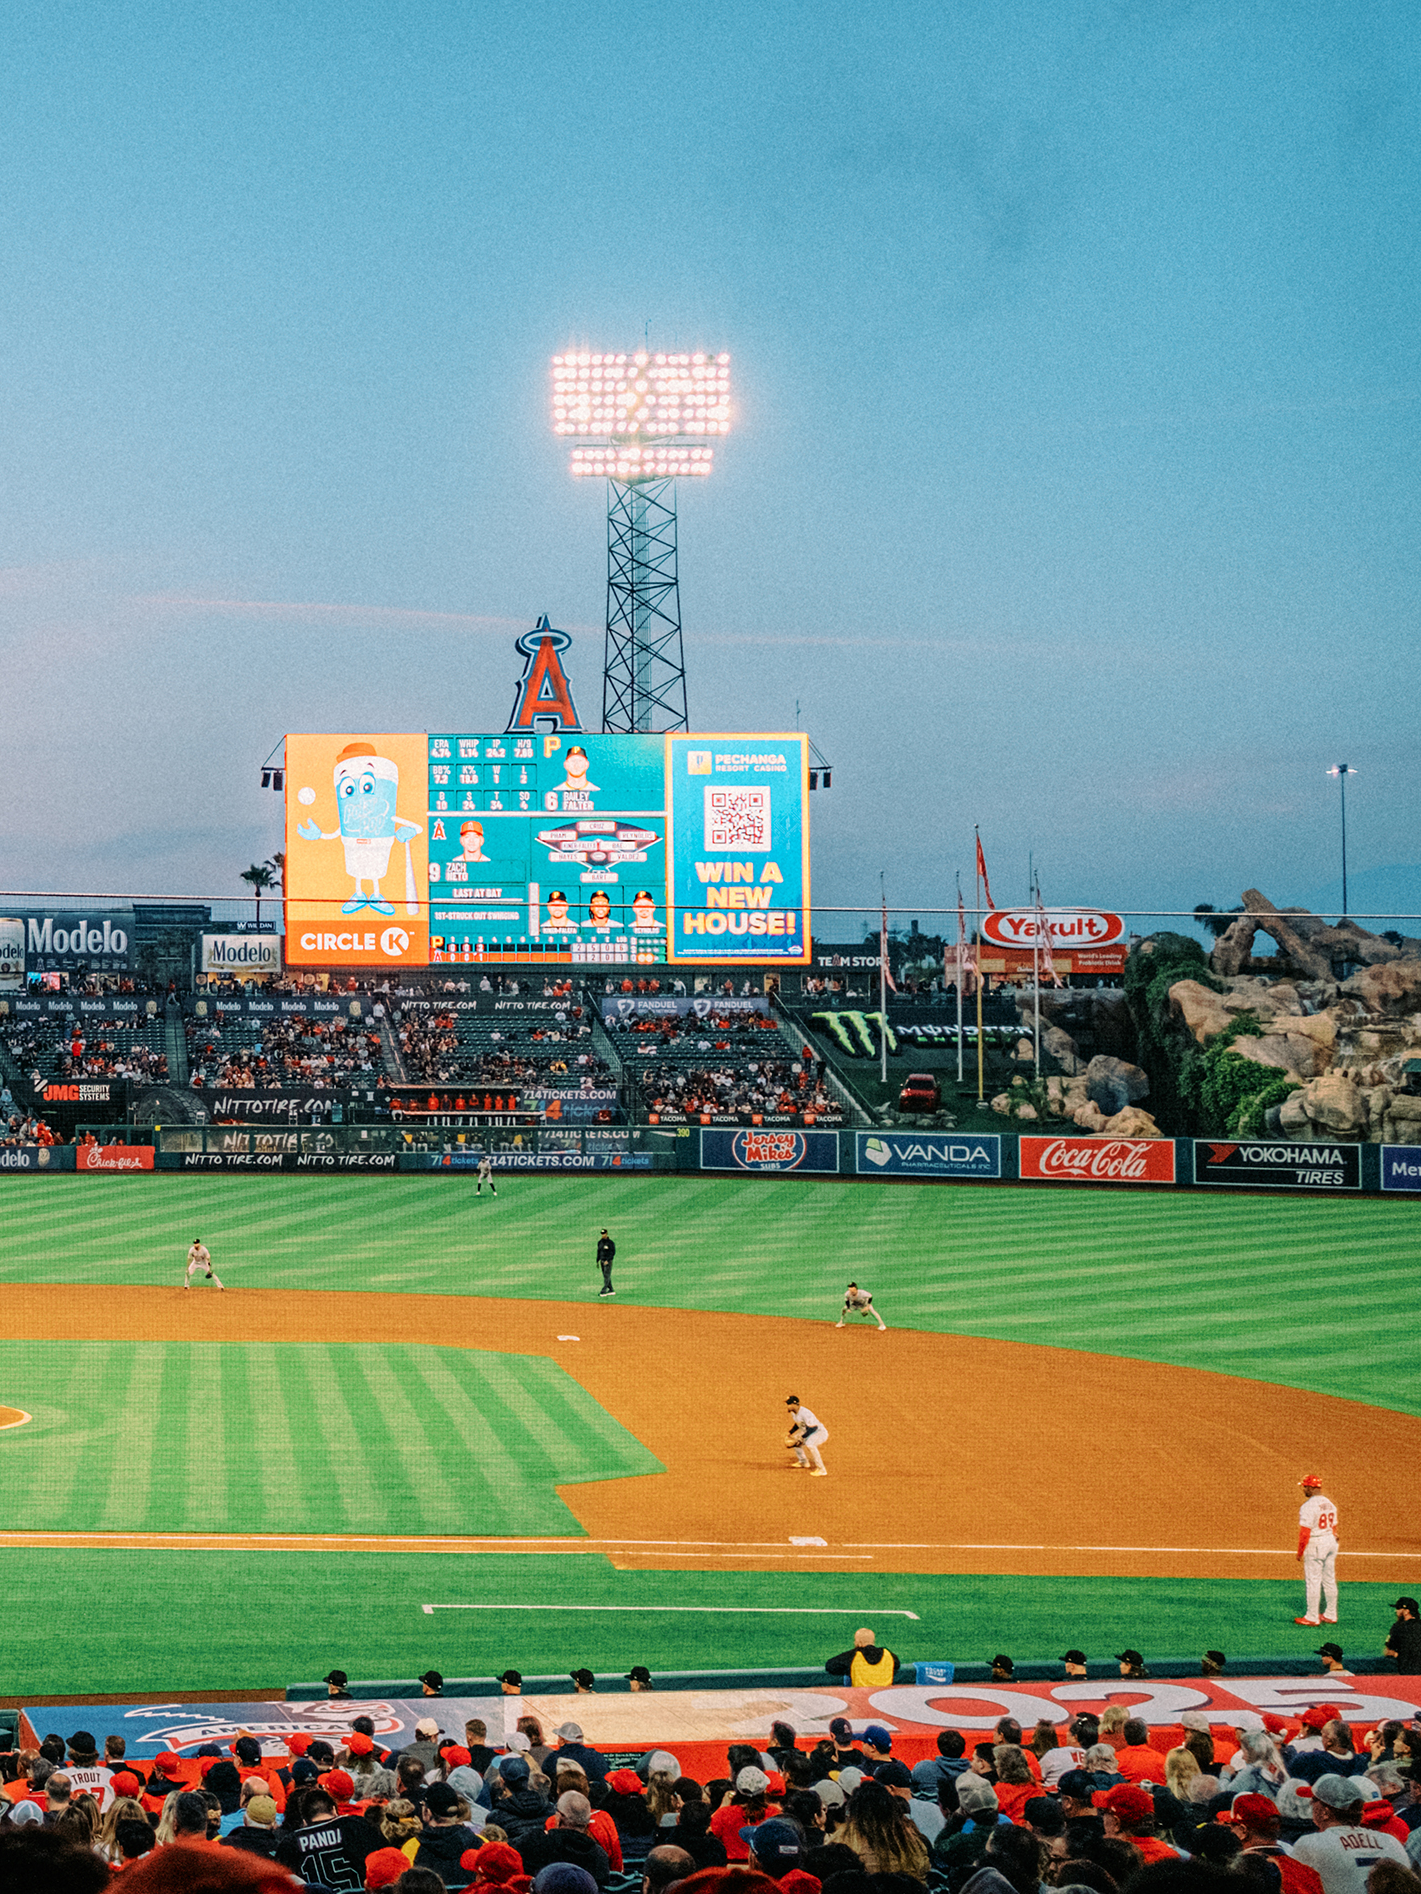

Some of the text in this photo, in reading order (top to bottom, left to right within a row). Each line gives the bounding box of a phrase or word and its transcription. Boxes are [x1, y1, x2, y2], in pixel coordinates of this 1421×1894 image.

[434, 740, 449, 748] ERA
[459, 740, 479, 748] WHIP
[492, 740, 501, 748] IP
[544, 736, 561, 758] P
[715, 754, 786, 765] PECHANGA
[462, 765, 476, 775] K%
[492, 766, 501, 775] W
[545, 792, 590, 811] 6 BAILEY
[563, 801, 594, 811] FALTER
[429, 863, 440, 882] 9
[695, 862, 784, 883] WIN A
[452, 888, 474, 898] LAST
[474, 888, 486, 898] AT
[707, 886, 773, 909] NEW
[683, 912, 796, 935] HOUSE!
[1006, 918, 1102, 937] Yakult
[27, 918, 128, 954] Modelo
[300, 927, 410, 956] CIRCLE K
[213, 940, 271, 962] Modelo
[817, 952, 851, 967] TEAM
[16, 1001, 41, 1011] Modelo
[48, 1001, 73, 1011] Modelo
[80, 1001, 106, 1011] Modelo
[112, 1001, 138, 1011] Modelo
[216, 1001, 241, 1011] Modelo
[249, 1001, 274, 1011] Modelo
[281, 1001, 306, 1011] Modelo
[314, 1001, 339, 1011] Modelo
[401, 1000, 476, 1010] NITTO TIRE.COM
[495, 1000, 571, 1010] NITTO TIRE.COM
[638, 1001, 677, 1009] FANDUEL
[714, 1001, 753, 1009] FANDUEL
[897, 1025, 1034, 1036] MONSTER
[43, 1085, 110, 1101] JMG SECURITY
[80, 1093, 110, 1101] SYSTEMS
[523, 1090, 617, 1100] 714TICKETS.COM
[712, 1115, 739, 1123] TACOMA
[764, 1115, 791, 1123] TACOMA
[816, 1115, 842, 1123] TACOMA
[676, 1127, 690, 1137] 390
[742, 1132, 796, 1148] Jersey
[746, 1146, 796, 1163] Mike's
[893, 1144, 991, 1162] VANDA
[1239, 1147, 1344, 1165] YOKOHAMA
[185, 1153, 283, 1167] NITTO TIRE.COM
[297, 1153, 396, 1167] NITTO TIRE.COM
[431, 1154, 479, 1166] 714tickets
[486, 1155, 595, 1167] 714TICKETS.COM
[601, 1155, 650, 1166] 714tickets
[1039, 1140, 1153, 1178] Coca-Cola
[901, 1162, 977, 1170] PHARMACEUTICALS
[1296, 1171, 1345, 1185] TIRES
[71, 1772, 101, 1785] TROUT
[1339, 1832, 1384, 1851] ADELL
